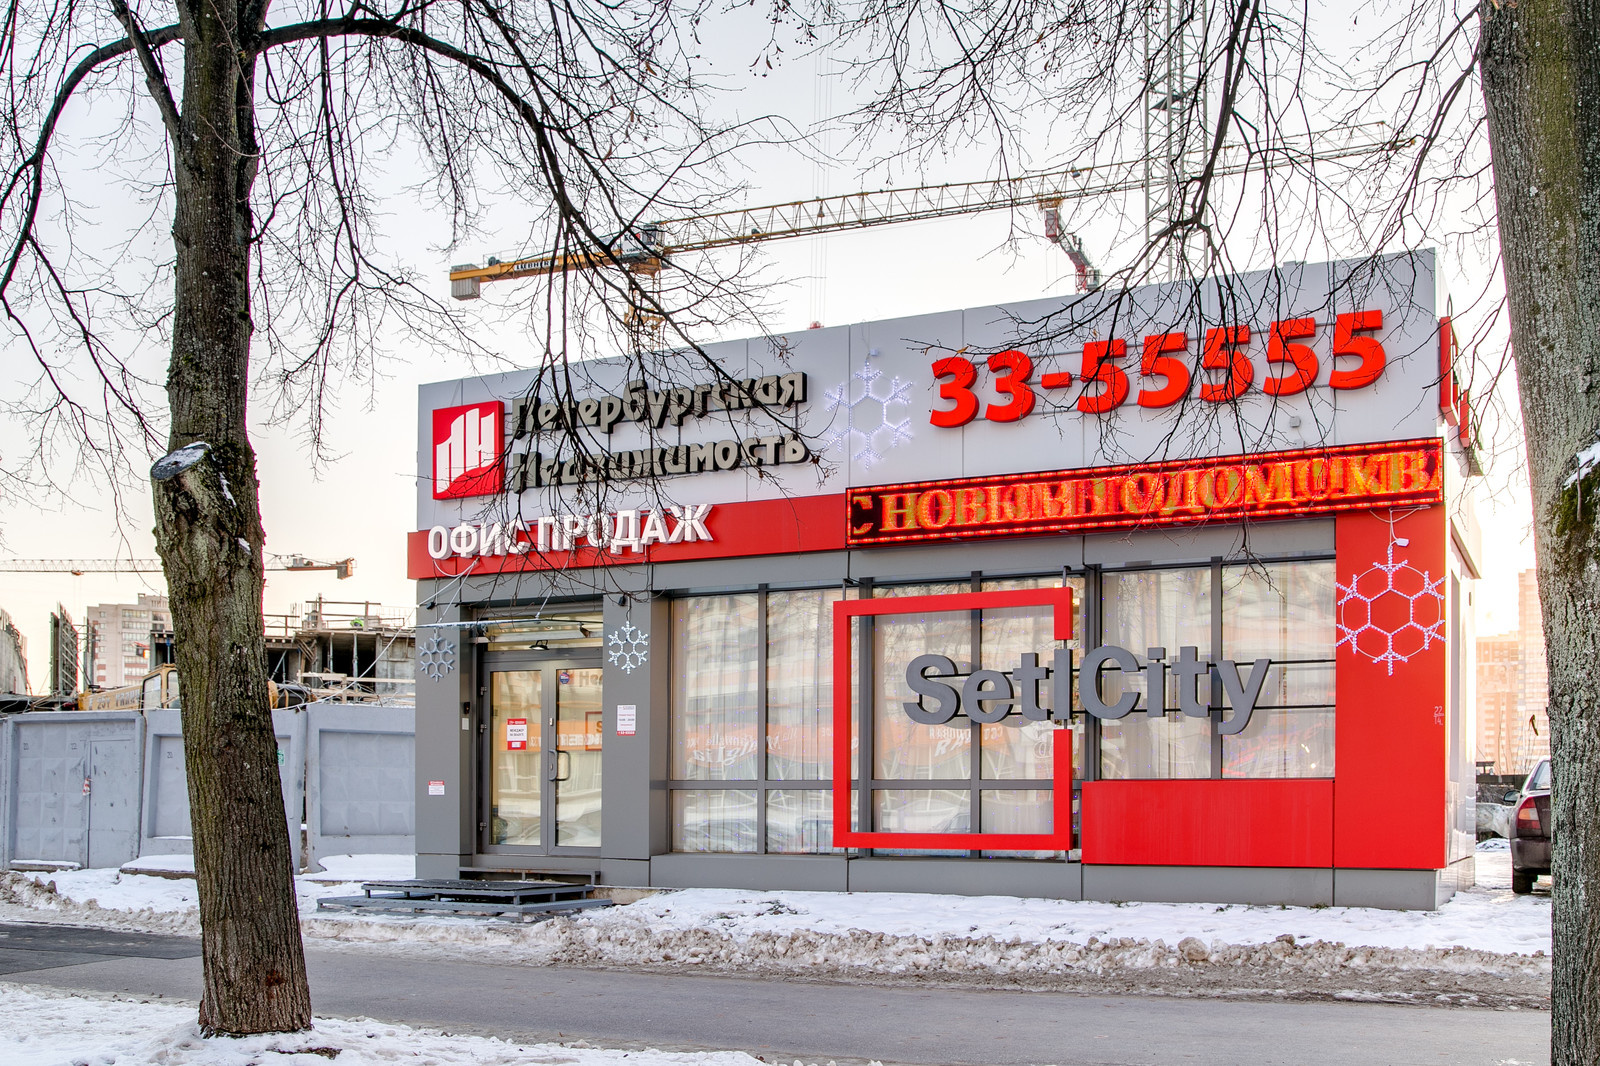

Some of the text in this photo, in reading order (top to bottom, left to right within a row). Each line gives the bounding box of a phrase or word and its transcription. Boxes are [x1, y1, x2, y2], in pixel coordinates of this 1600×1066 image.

[516, 260, 557, 271] LIEBHER
[930, 310, 1386, 428] 33-55555
[428, 504, 713, 560] ОФИС ПРОДАЖ
